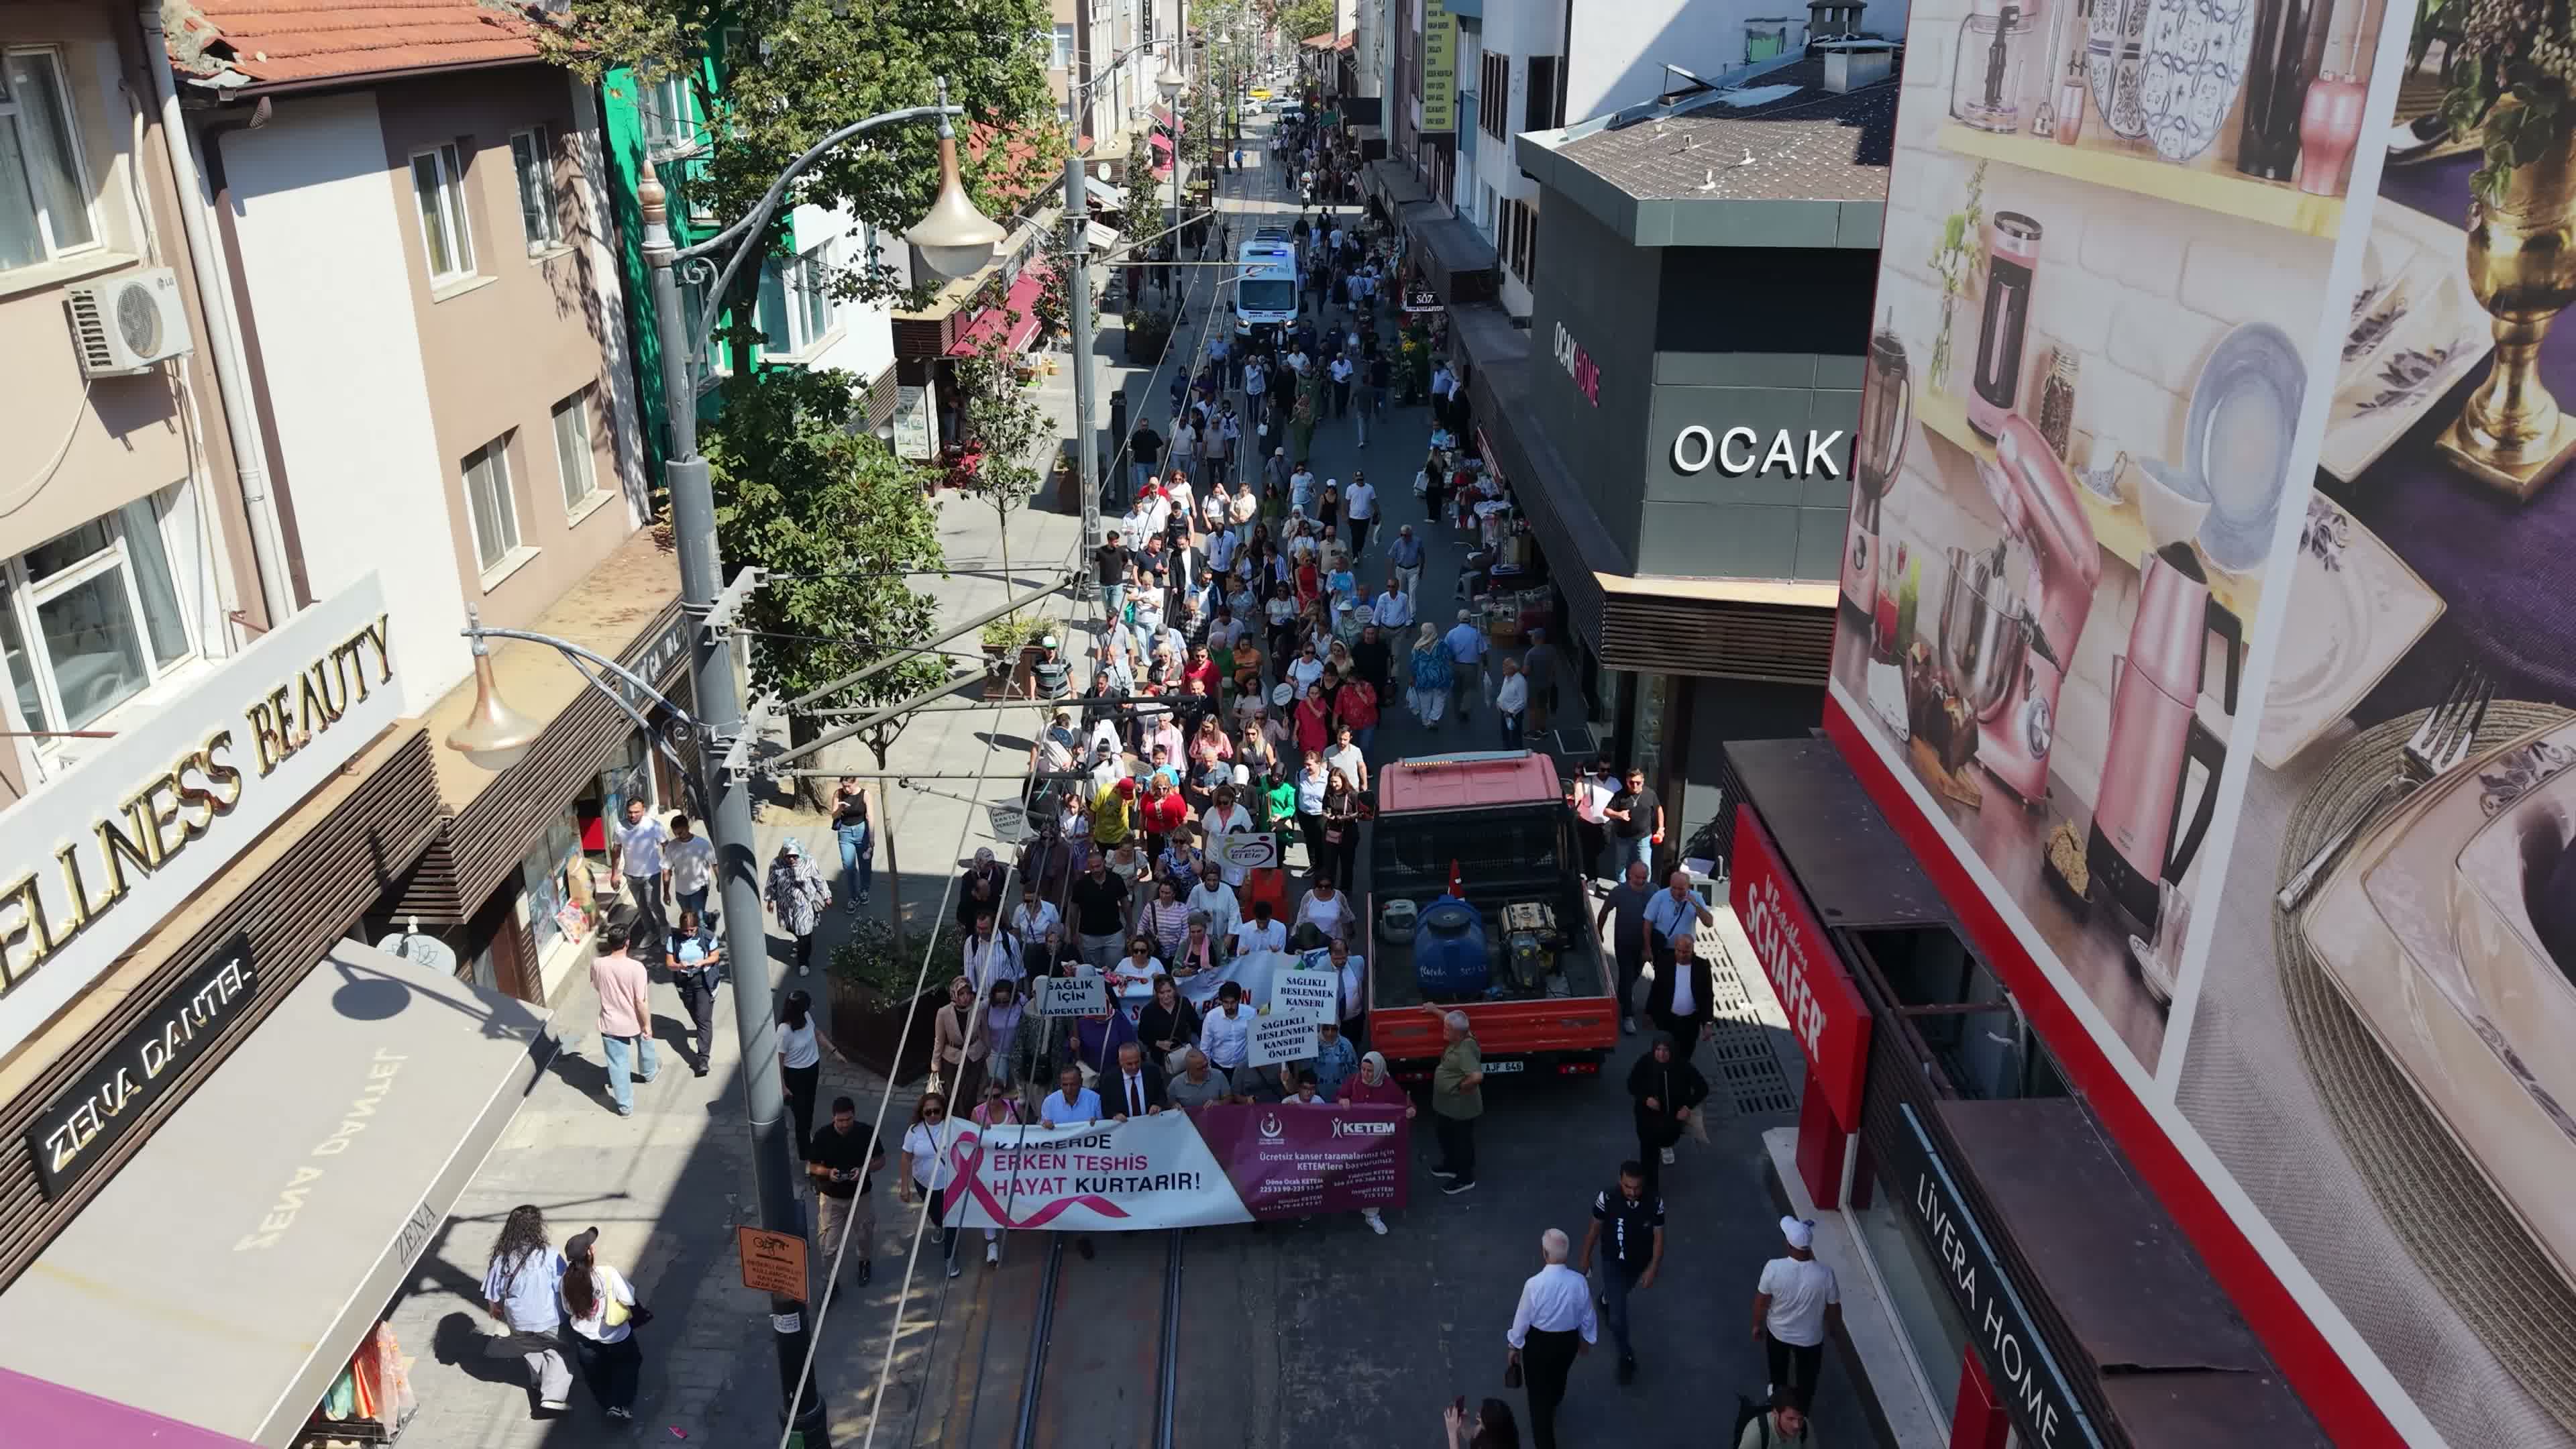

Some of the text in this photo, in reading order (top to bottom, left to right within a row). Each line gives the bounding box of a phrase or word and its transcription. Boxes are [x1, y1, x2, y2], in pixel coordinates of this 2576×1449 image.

[1674, 425, 1860, 476] OCAK
[243, 613, 393, 778] BEAUTY
[1747, 881, 1820, 1063] SCHAFER
[1047, 979, 1093, 990] SAĞLIK
[1280, 987, 1334, 998] BESLENMEK
[1057, 990, 1085, 1003] İÇİN
[1285, 998, 1324, 1008] KANSERİ
[1256, 1024, 1315, 1041] BESLENMEK
[1263, 1036, 1305, 1050] KANSERİ
[1268, 1046, 1301, 1059] ÖNLER
[46, 958, 252, 1173] ZENA DANTEL
[1343, 1122, 1395, 1134] KETEM
[994, 1153, 1066, 1171] ERKEN
[1073, 1152, 1148, 1175] TEŞHİS
[1259, 1151, 1293, 1161] Ücretsiz
[1295, 1151, 1323, 1161] kanser
[993, 1172, 1200, 1196] HAYAT KURTARIR!
[394, 1201, 436, 1265] ZENA
[1917, 1173, 2059, 1449] LİVERA HOME
